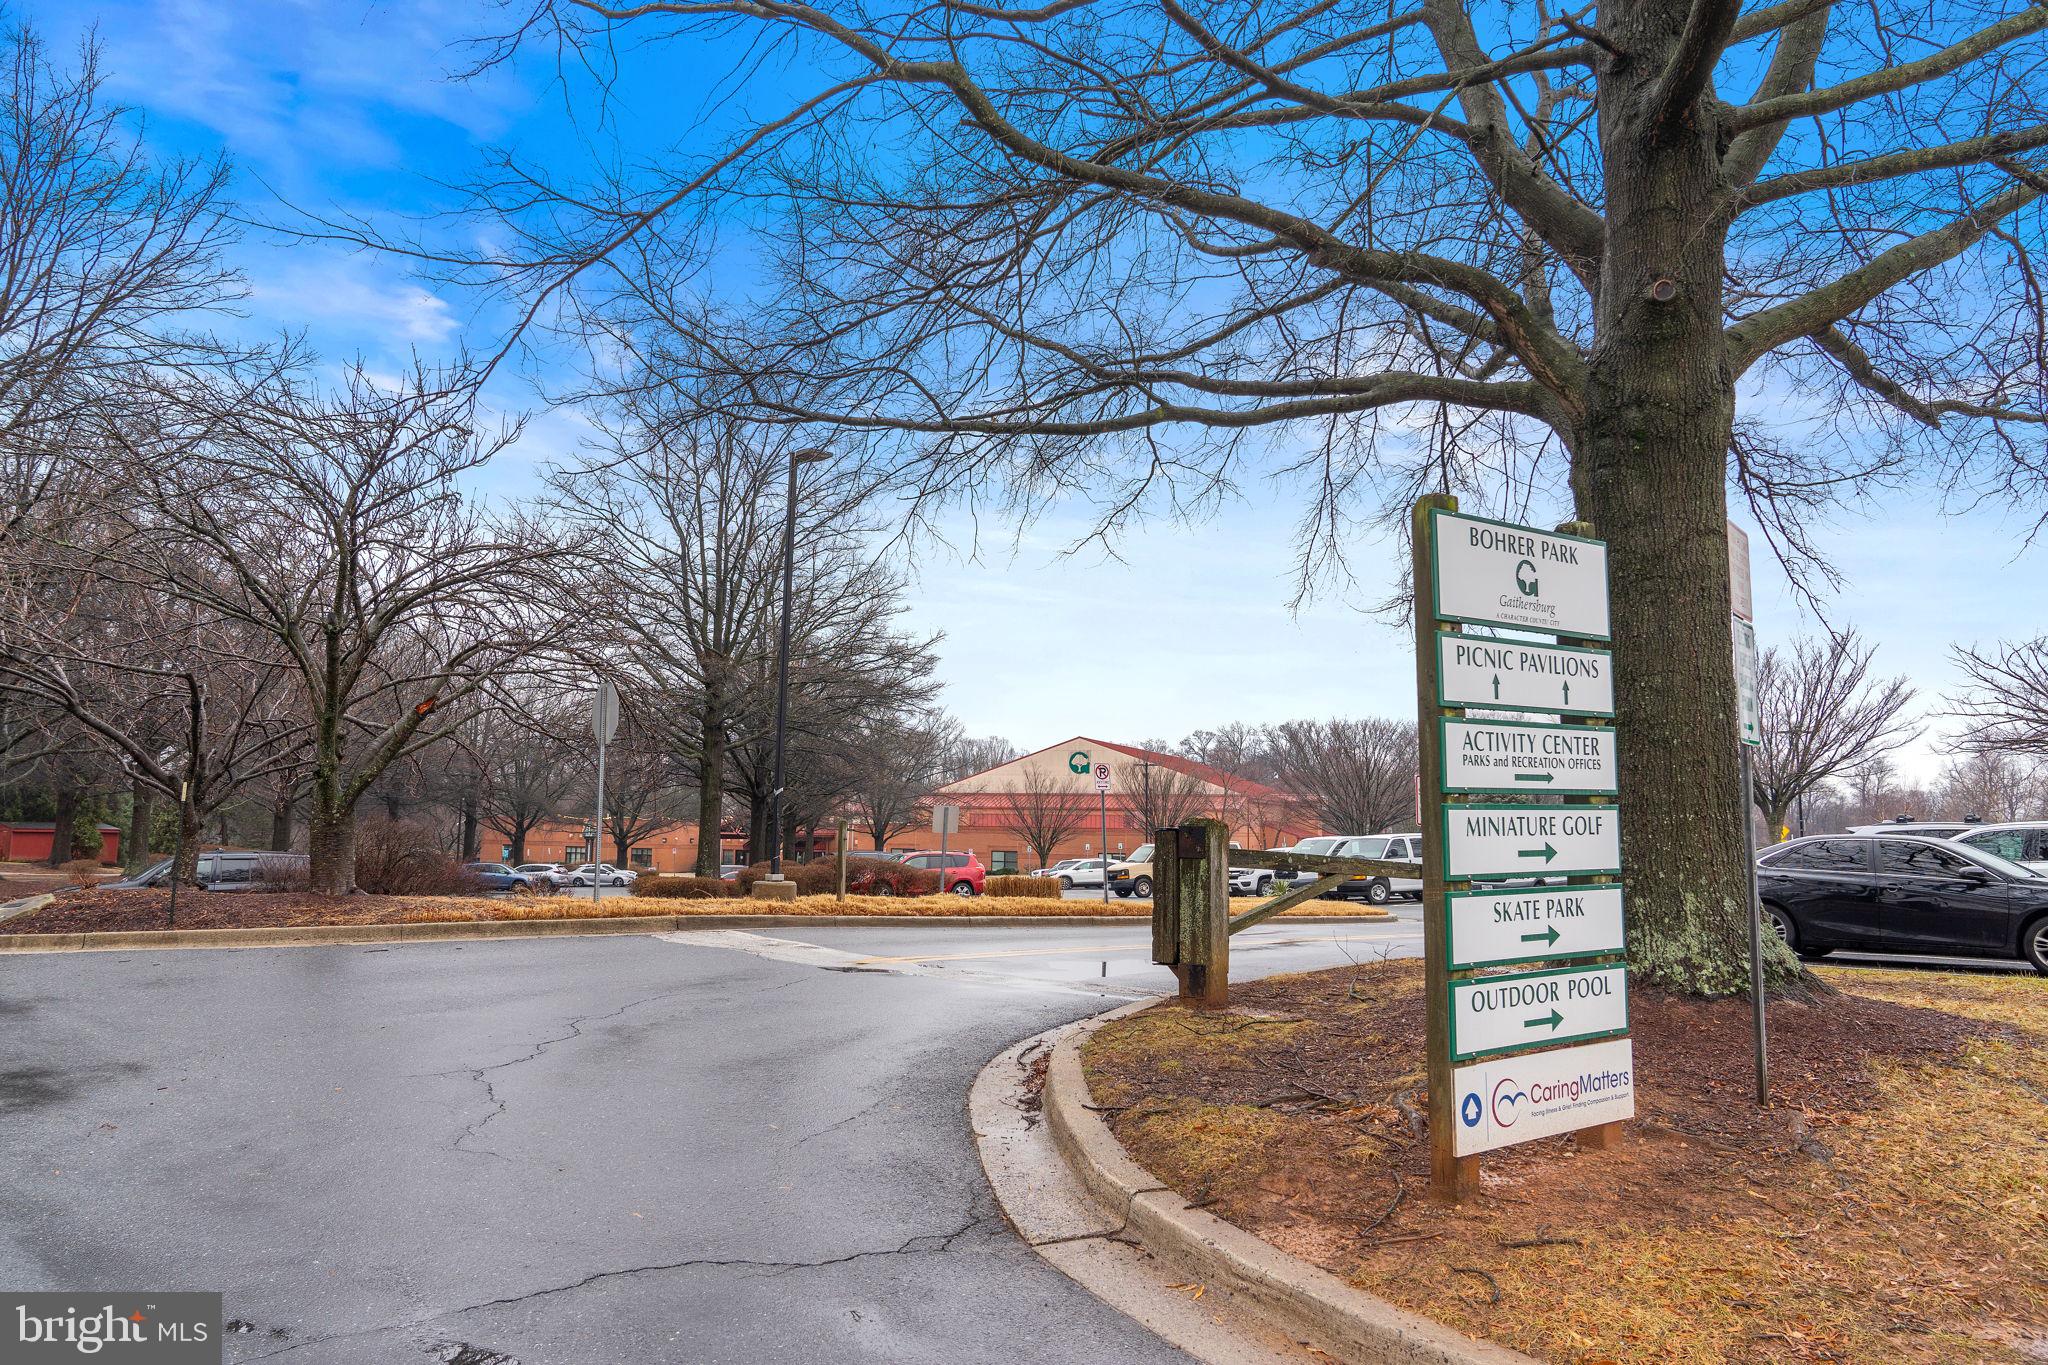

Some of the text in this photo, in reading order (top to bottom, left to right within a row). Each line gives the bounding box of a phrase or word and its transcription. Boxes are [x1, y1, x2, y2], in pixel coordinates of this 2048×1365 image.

[1469, 526, 1579, 565] BOHRER PARK
[1500, 594, 1556, 619] Gaithersburg
[1456, 645, 1599, 679] PICNIC PAVILIONS
[1462, 730, 1600, 756] ACTIVITY CENTER
[1462, 754, 1602, 770] PARKS and RECREATION OFFICES
[1466, 816, 1603, 837] MINIATURE GOLF
[1493, 897, 1585, 923] SKATE PARK
[1471, 976, 1612, 1013] OUTDOOR POOL
[1530, 1070, 1629, 1104] CaringMatters
